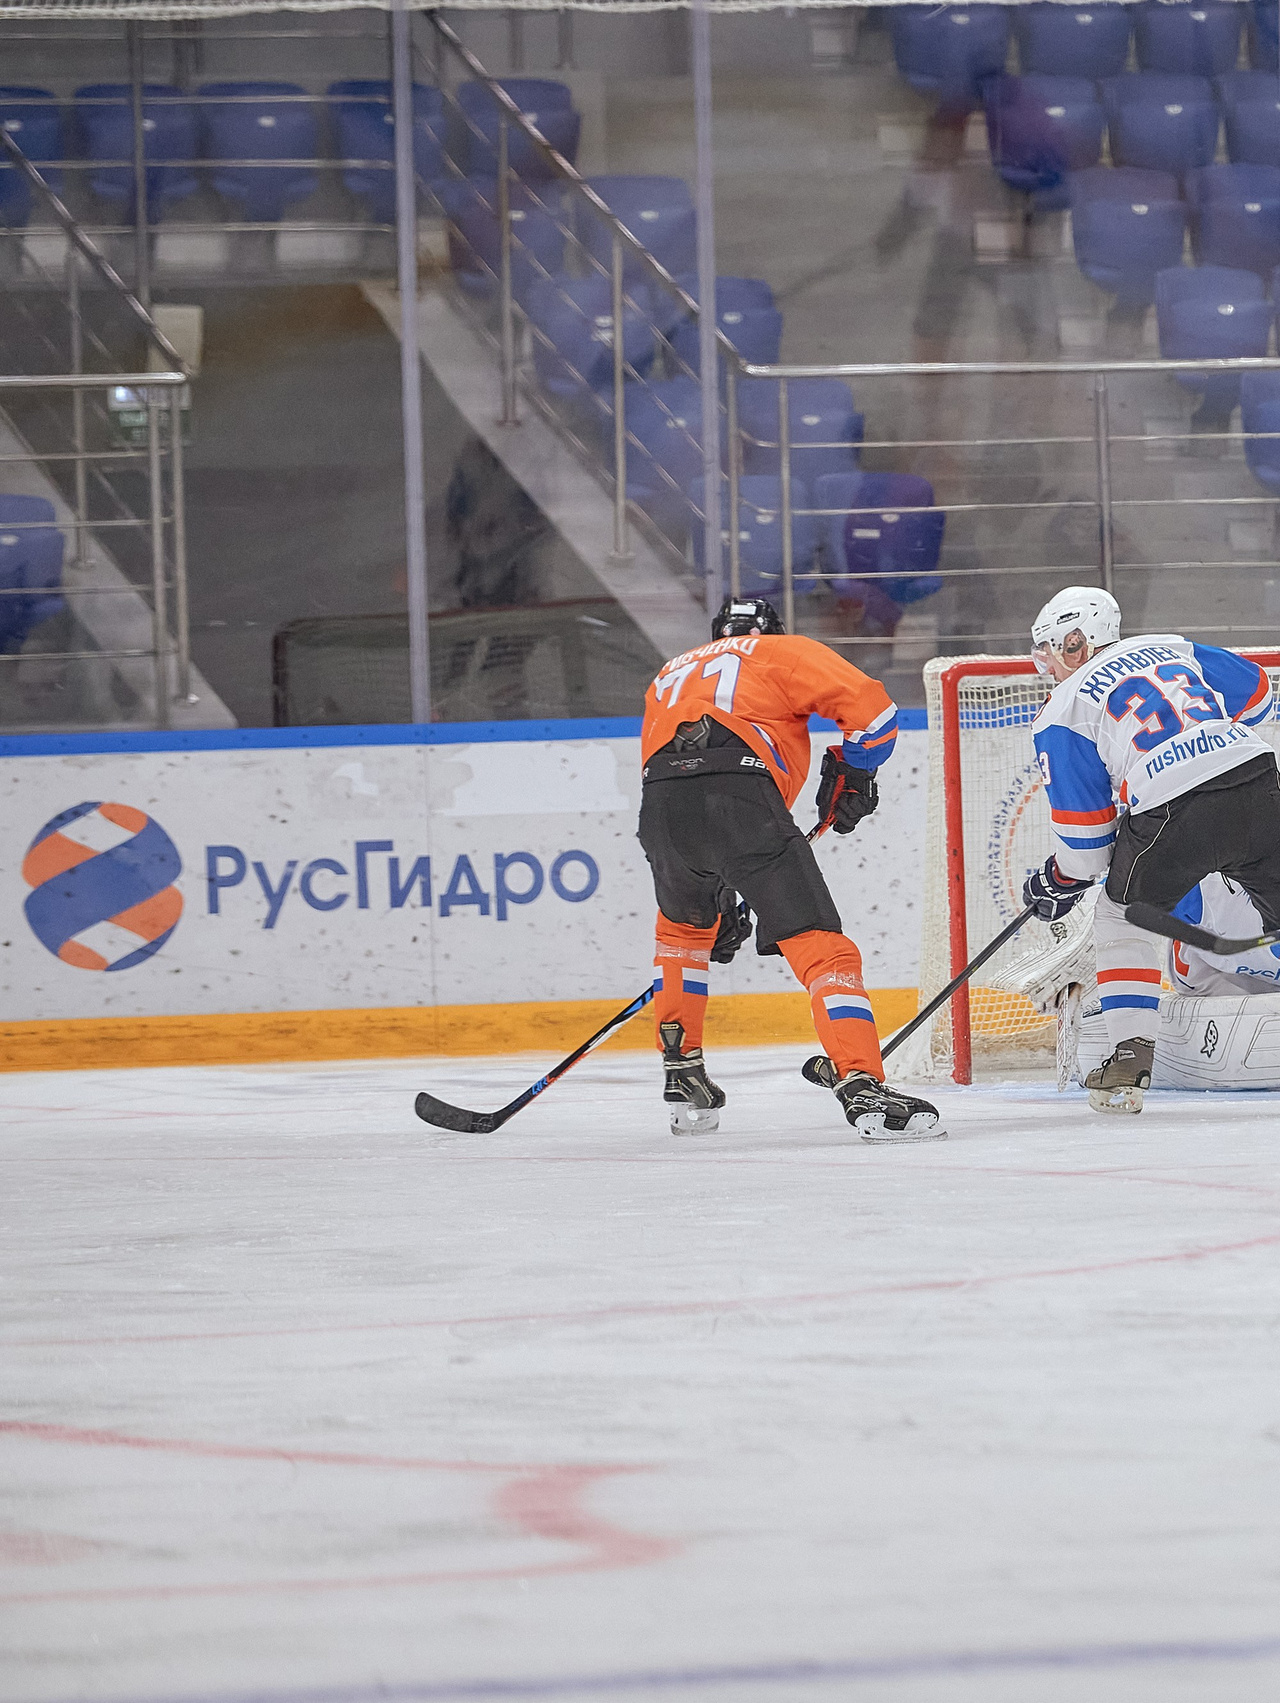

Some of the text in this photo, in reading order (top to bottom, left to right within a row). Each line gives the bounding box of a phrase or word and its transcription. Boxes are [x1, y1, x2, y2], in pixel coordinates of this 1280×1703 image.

[654, 652, 742, 714] 71
[1079, 646, 1182, 704] ЖУРАВЛЕВ
[1106, 662, 1224, 753] 33
[1144, 726, 1250, 780] rushydro.ru
[205, 839, 601, 929] РусГидро
